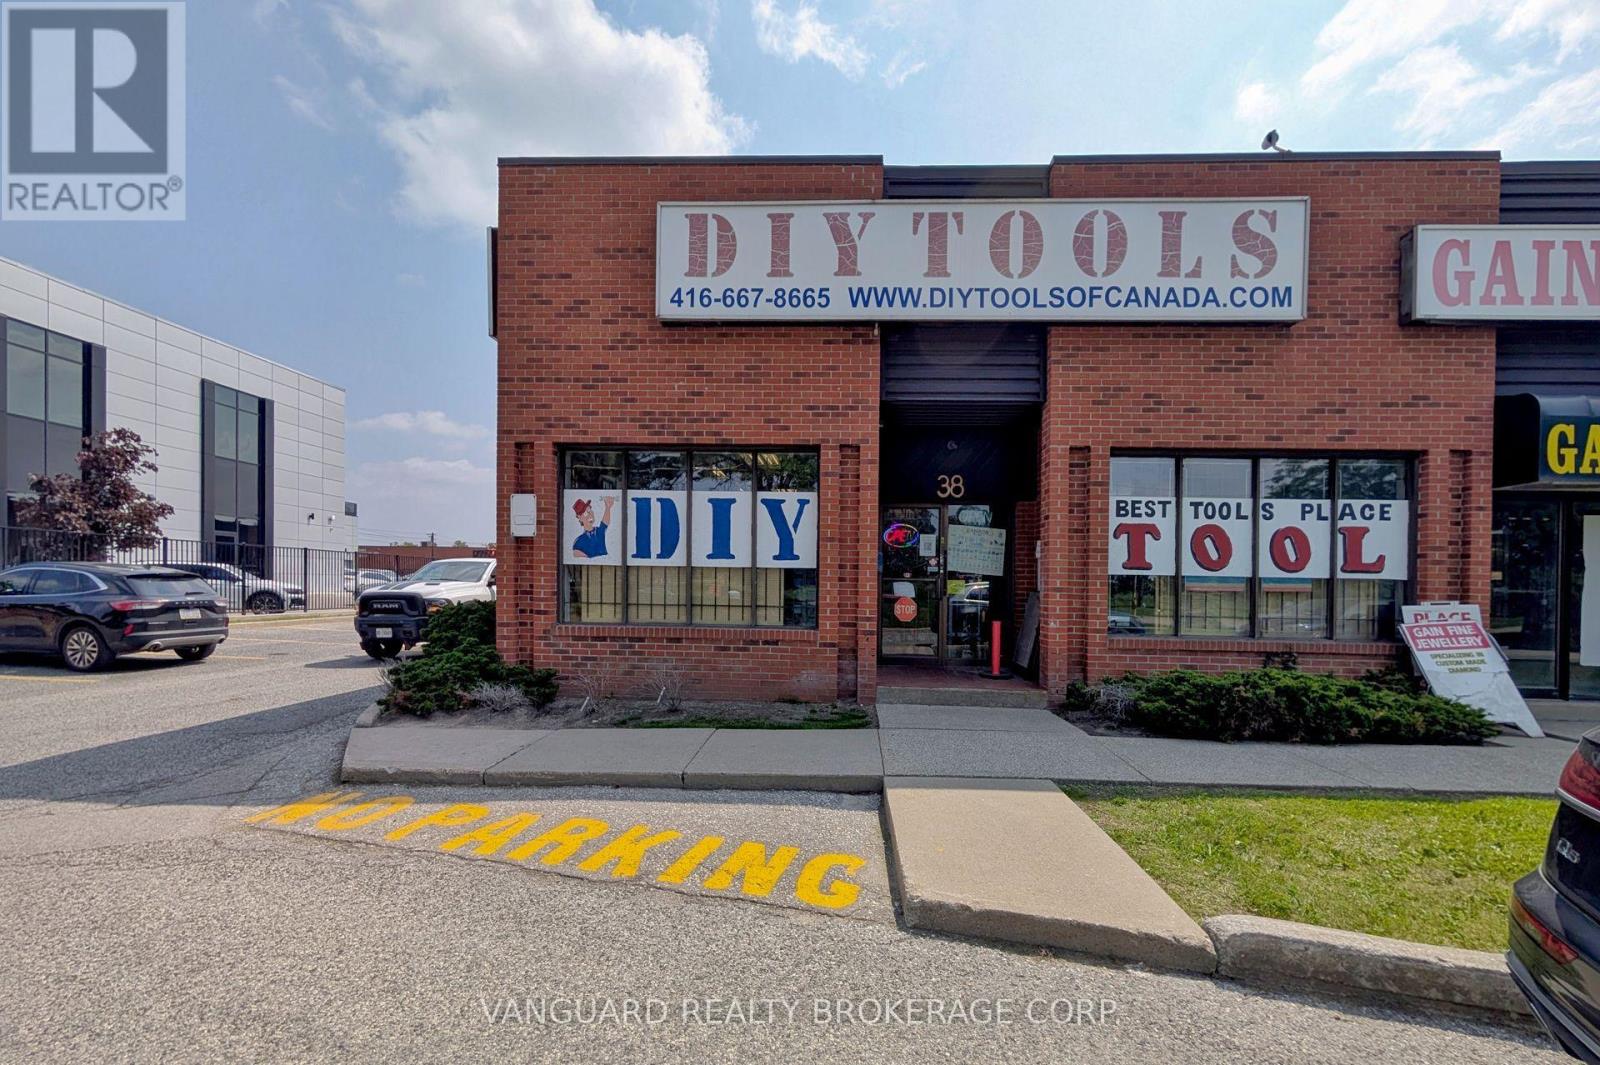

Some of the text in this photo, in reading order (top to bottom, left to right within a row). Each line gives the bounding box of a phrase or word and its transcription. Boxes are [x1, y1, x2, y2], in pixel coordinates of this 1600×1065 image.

[684, 209, 1279, 279] DIY TOOLS
[1432, 238, 1600, 307] GAIN
[670, 286, 1293, 309] 416-667-8665 WWW.DIYTOOLSOFCANADA.COM
[937, 474, 965, 498] 38
[1115, 500, 1172, 519] BEST
[1300, 502, 1393, 522] PLACE
[631, 497, 810, 561] DIY
[1112, 522, 1386, 574] TOOL
[895, 604, 916, 614] STOP
[1413, 624, 1475, 637] GAIN FINE
[1416, 636, 1483, 649] JEWELLERY
[244, 791, 868, 909] NO PARKING
